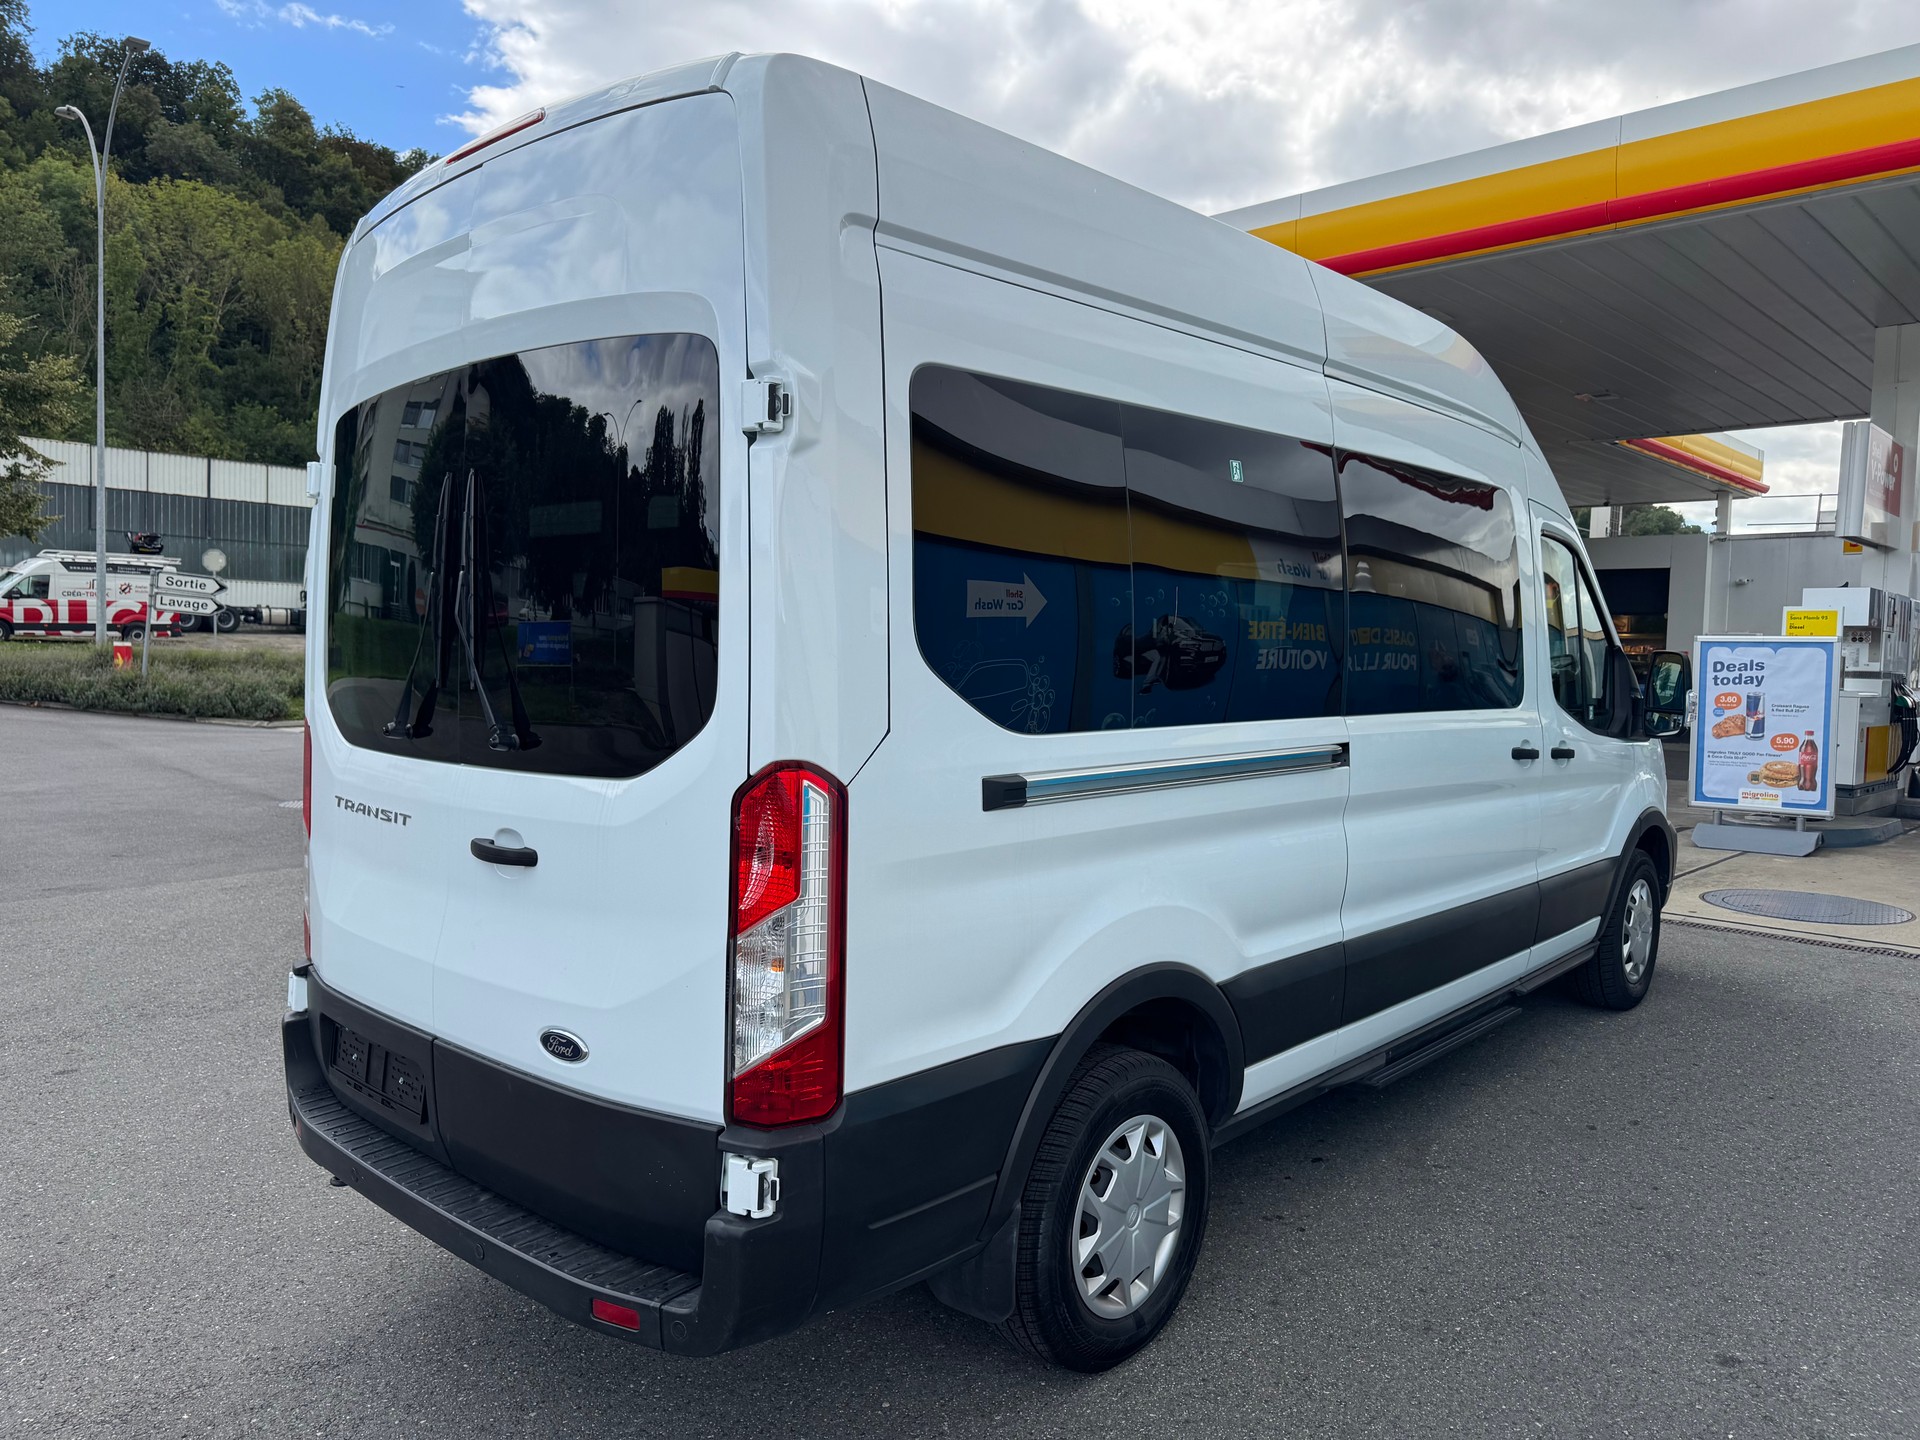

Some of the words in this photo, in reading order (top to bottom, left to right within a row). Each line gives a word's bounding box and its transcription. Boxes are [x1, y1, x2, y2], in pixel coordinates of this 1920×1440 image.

[165, 576, 207, 590] Sortie
[160, 595, 209, 611] Lavage
[1712, 659, 1765, 673] Deals
[1712, 673, 1765, 687] today
[1719, 695, 1738, 703] 3.60
[1775, 736, 1795, 744] 5.90
[1741, 790, 1779, 799] migrolino
[335, 795, 412, 826] TRANSIT
[547, 1035, 574, 1057] Ford
